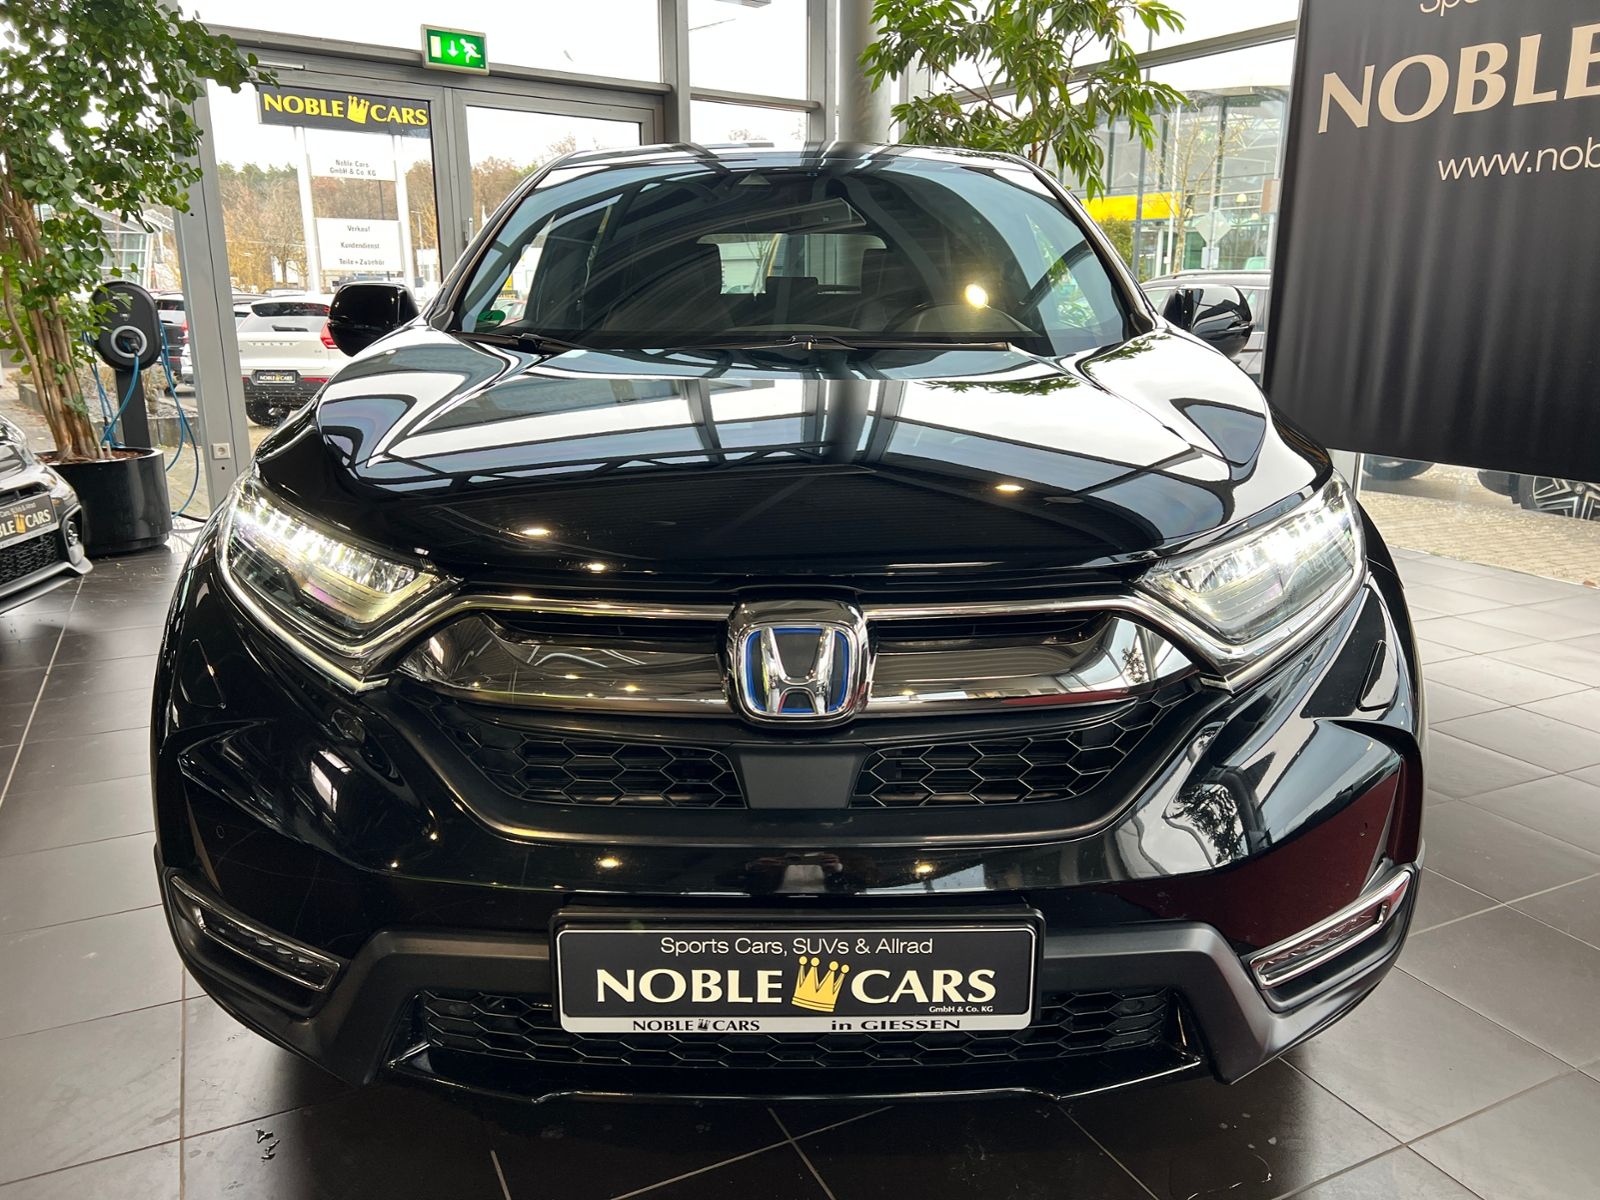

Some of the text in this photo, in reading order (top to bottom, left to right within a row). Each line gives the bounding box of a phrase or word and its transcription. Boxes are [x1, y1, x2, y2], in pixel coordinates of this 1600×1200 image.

[1318, 22, 1600, 134] NOBLE
[263, 93, 428, 126] NOBLE CARS
[335, 159, 369, 168] Noble Cars
[329, 166, 348, 174] GmbH
[367, 169, 377, 177] KG
[340, 242, 380, 250] Kundendienst
[25, 509, 51, 527] CARS
[660, 937, 934, 957] Sports Cars, SUVs & Allrad
[596, 968, 997, 1004] NOBLE CARS
[928, 1005, 994, 1013] GmbH & Co. KG
[632, 1019, 760, 1031] NOBLE CARS
[831, 1019, 960, 1031] in GIESSEN
